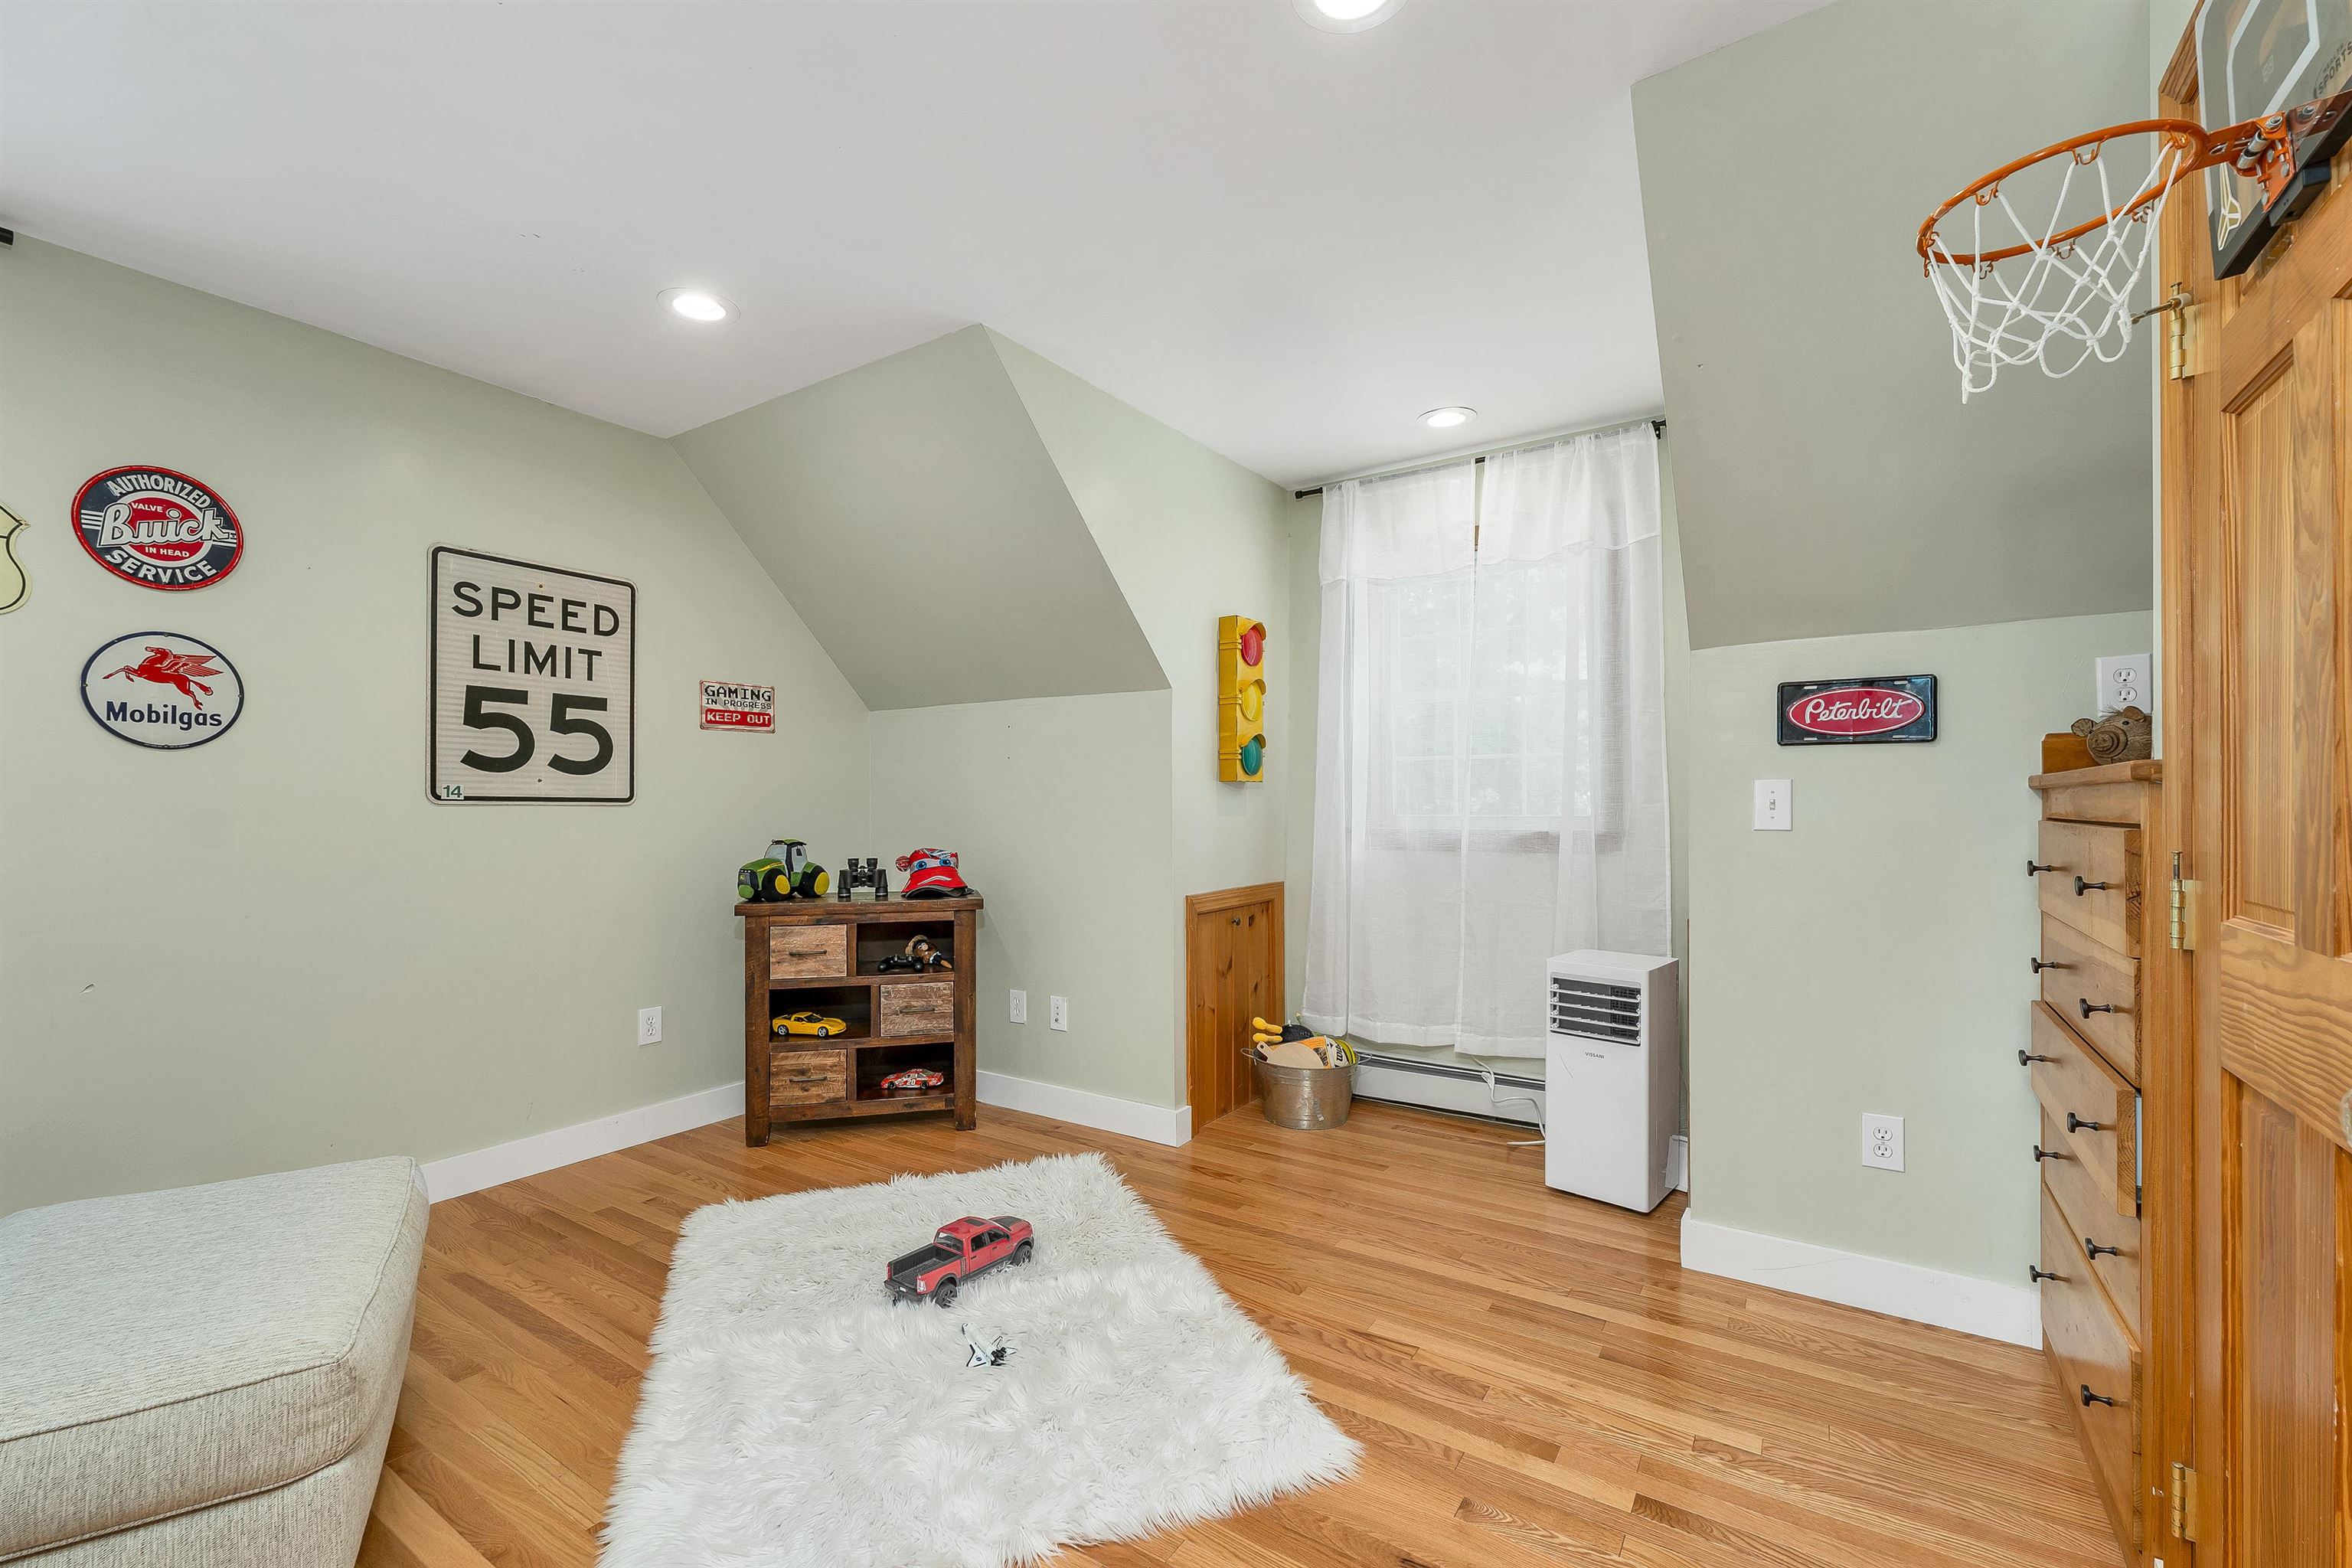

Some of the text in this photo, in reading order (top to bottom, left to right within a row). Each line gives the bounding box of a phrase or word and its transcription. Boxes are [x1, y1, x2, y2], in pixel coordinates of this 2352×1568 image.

[106, 474, 211, 508] AUTHORIZED
[131, 502, 163, 513] VALVE
[97, 503, 230, 547] Buick
[106, 550, 217, 583] SERVICE
[160, 548, 190, 557] HEAD
[452, 581, 620, 636] SPEED
[472, 634, 603, 681] LIMIT
[704, 685, 771, 702] GAMING
[724, 699, 772, 710] PROGRESS
[106, 701, 223, 730] Mobilgas
[707, 711, 770, 724] KEEP OUT
[1805, 697, 1913, 724] Peterbilt
[459, 684, 614, 776] 55
[443, 785, 462, 798] 14
